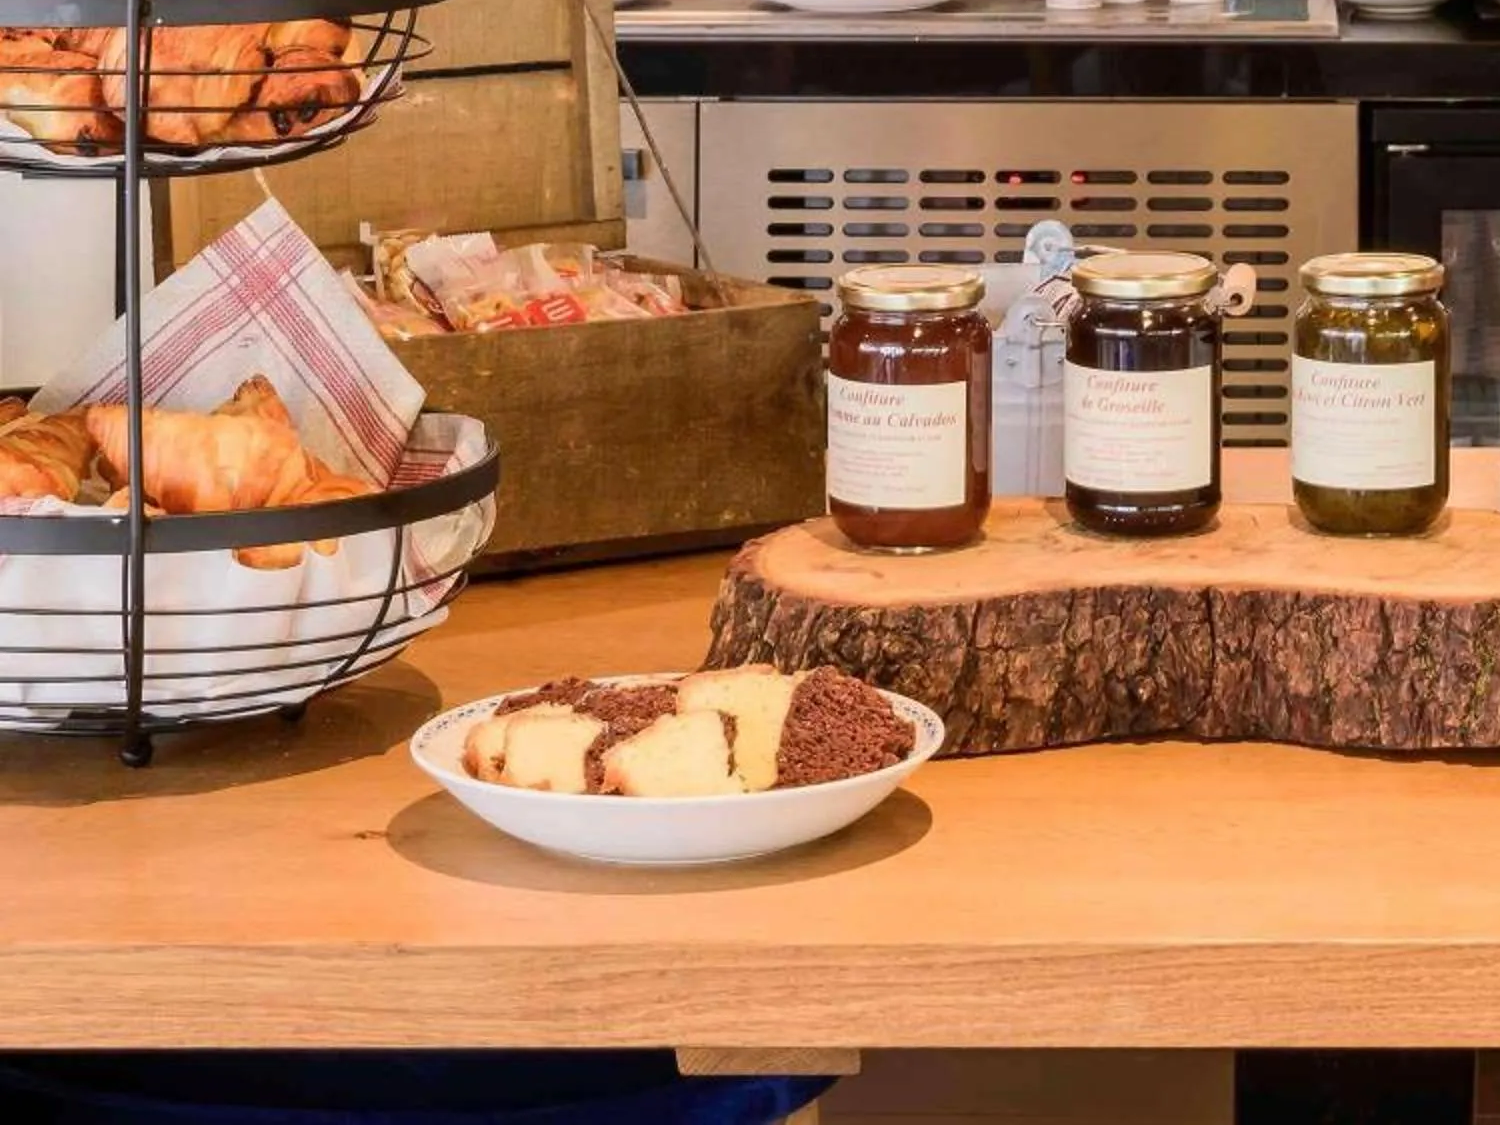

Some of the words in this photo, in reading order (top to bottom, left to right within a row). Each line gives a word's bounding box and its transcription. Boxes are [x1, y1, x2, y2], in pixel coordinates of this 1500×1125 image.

[1087, 374, 1160, 394] Confiture
[1311, 372, 1381, 390] Confiture
[839, 386, 906, 407] Confiture
[1098, 396, 1166, 414] Groseille
[1341, 392, 1392, 409] Citron
[1397, 392, 1426, 407] Vert
[862, 416, 881, 426] au
[887, 412, 957, 428] Calvados
